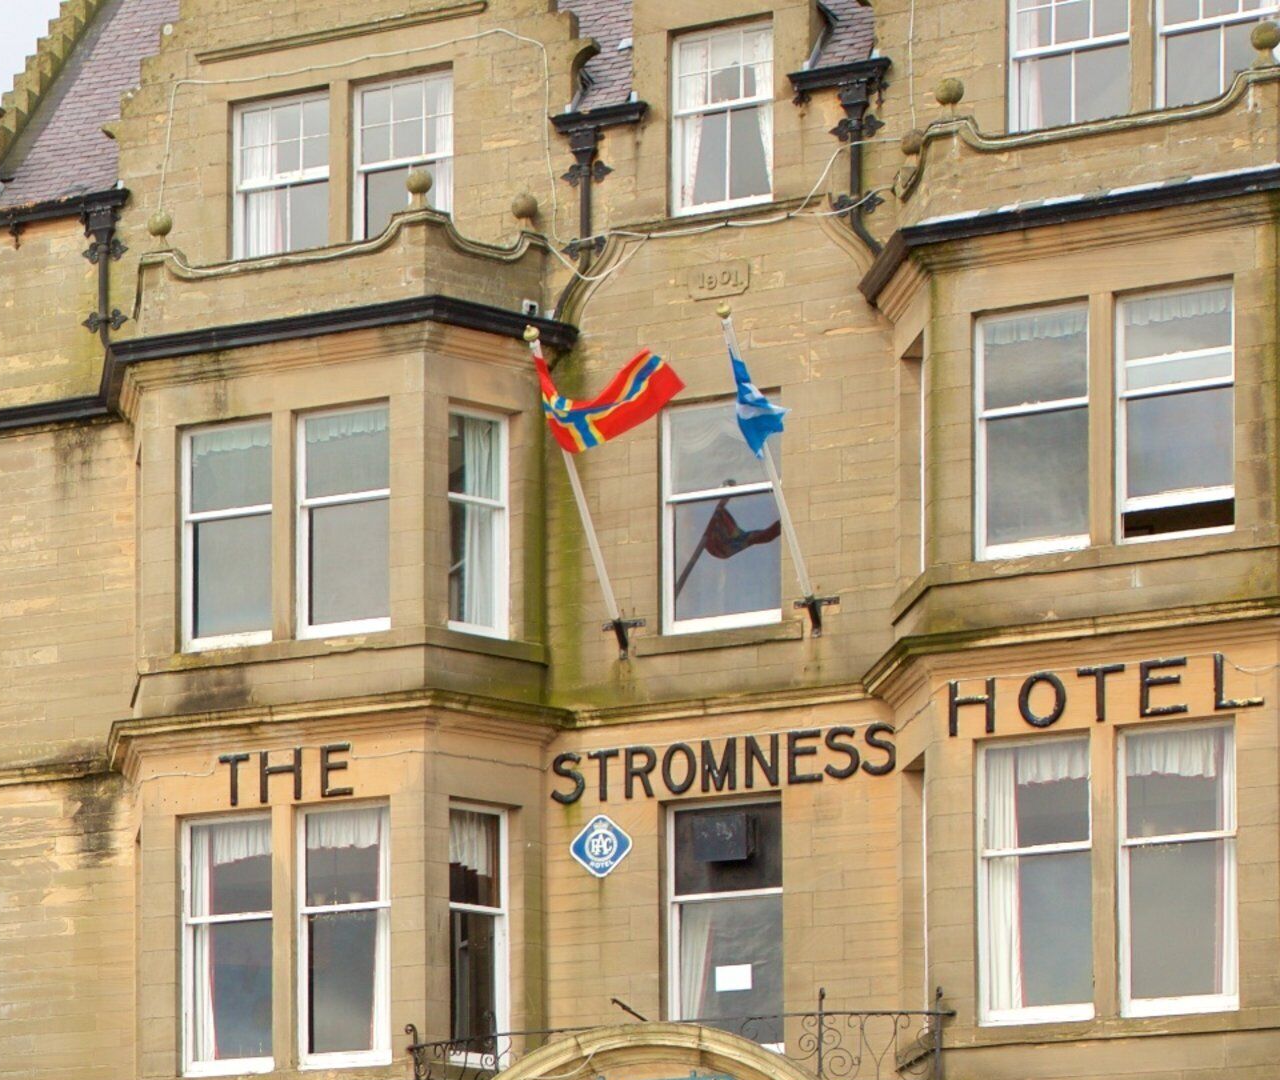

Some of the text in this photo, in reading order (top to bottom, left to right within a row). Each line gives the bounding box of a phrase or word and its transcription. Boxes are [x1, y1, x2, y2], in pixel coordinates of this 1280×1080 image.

[219, 652, 1265, 806] THE STROMNESS HOTEL
[591, 834, 613, 855] RAC
[590, 860, 614, 869] HOTEL
